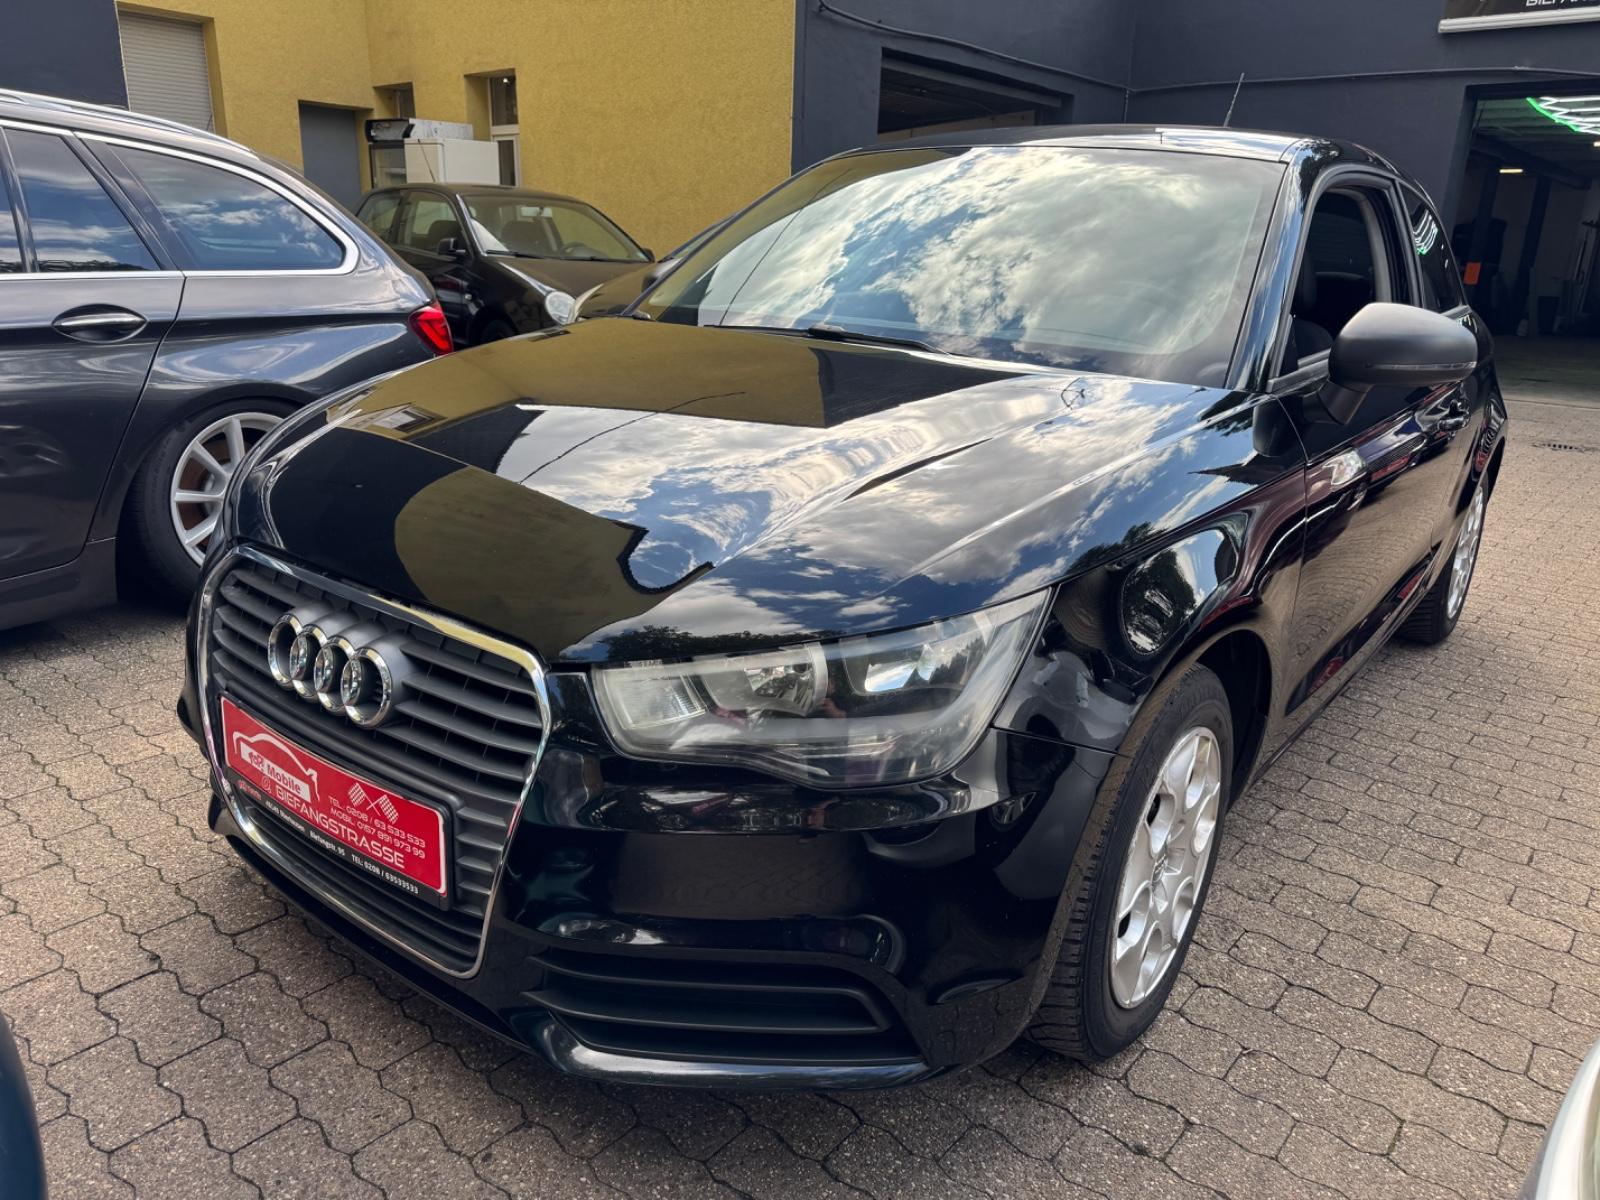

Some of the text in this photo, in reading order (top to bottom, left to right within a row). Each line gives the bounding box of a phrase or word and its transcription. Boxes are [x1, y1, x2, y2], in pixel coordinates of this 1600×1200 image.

[267, 764, 301, 794] Mobile
[277, 786, 404, 868] BIEFANGSTRASSE
[346, 806, 368, 822] 0208
[374, 818, 386, 831] 63
[387, 824, 405, 839] 533
[407, 833, 426, 848] 533
[364, 861, 380, 875] 0208
